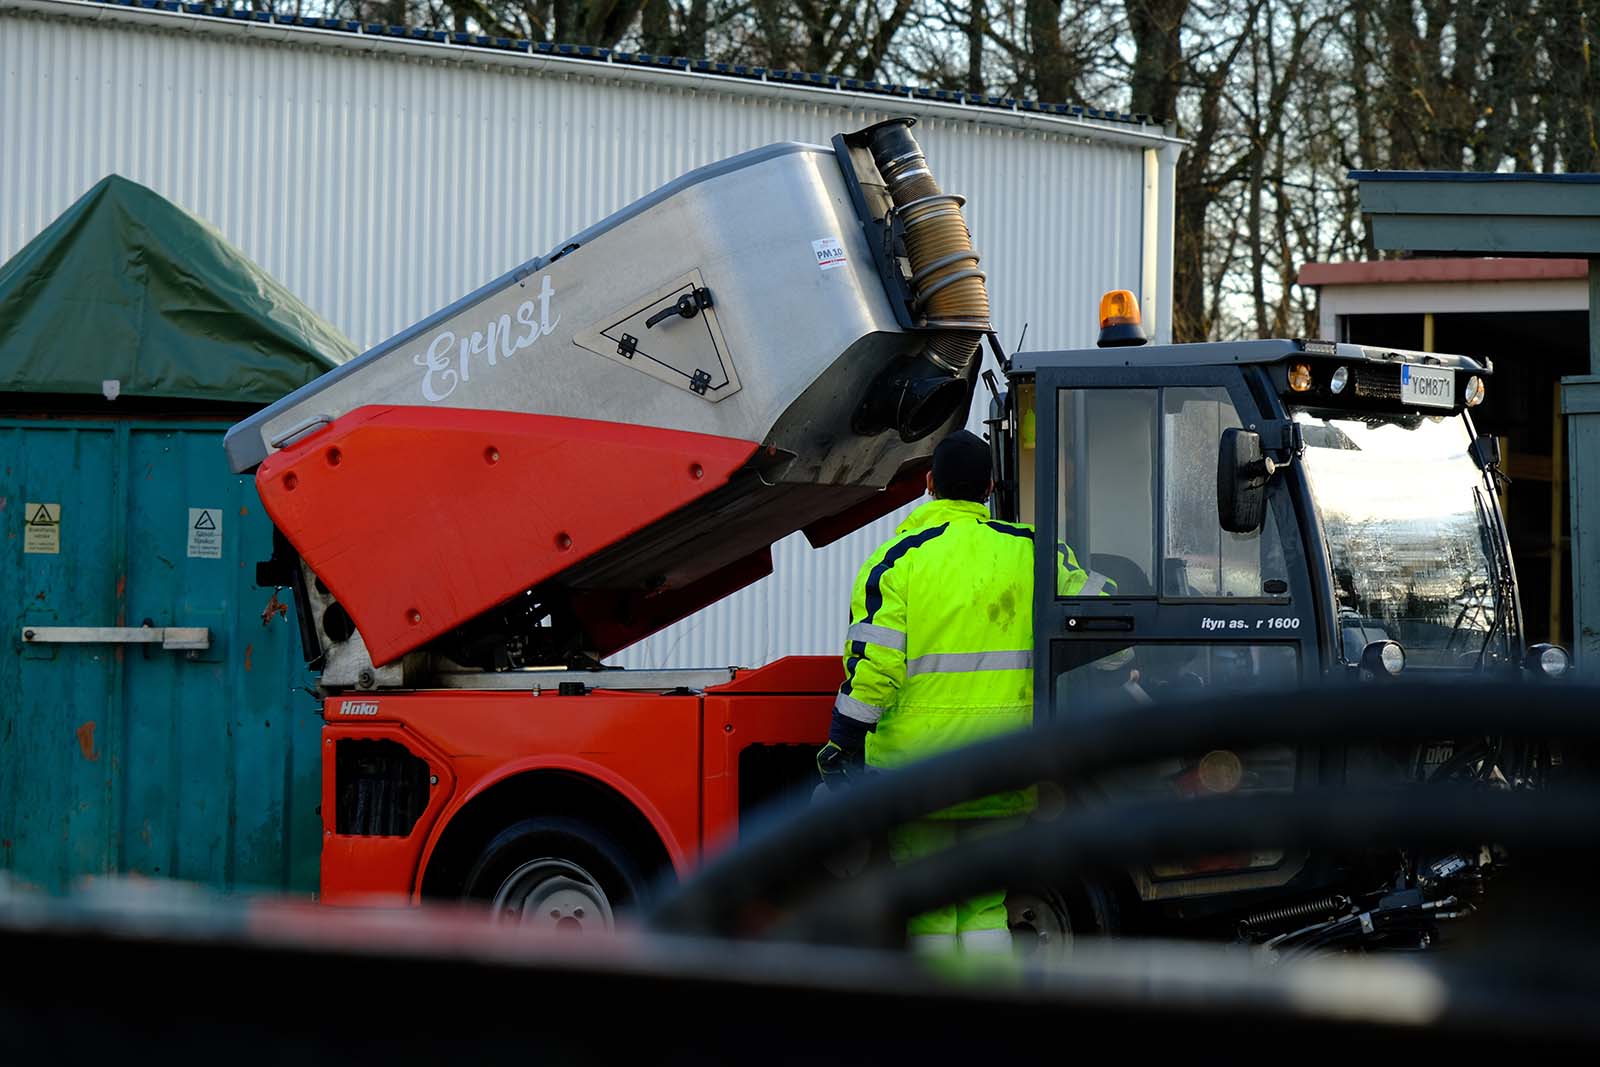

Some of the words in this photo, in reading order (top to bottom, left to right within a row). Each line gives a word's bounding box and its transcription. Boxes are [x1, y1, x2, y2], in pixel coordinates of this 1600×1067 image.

[817, 249, 832, 259] PM
[833, 248, 843, 256] 10
[413, 275, 560, 401] Ernst
[1412, 377, 1450, 397] YGM871
[1256, 619, 1263, 629] r
[1267, 618, 1300, 629] 1600
[340, 700, 378, 715] Hako
